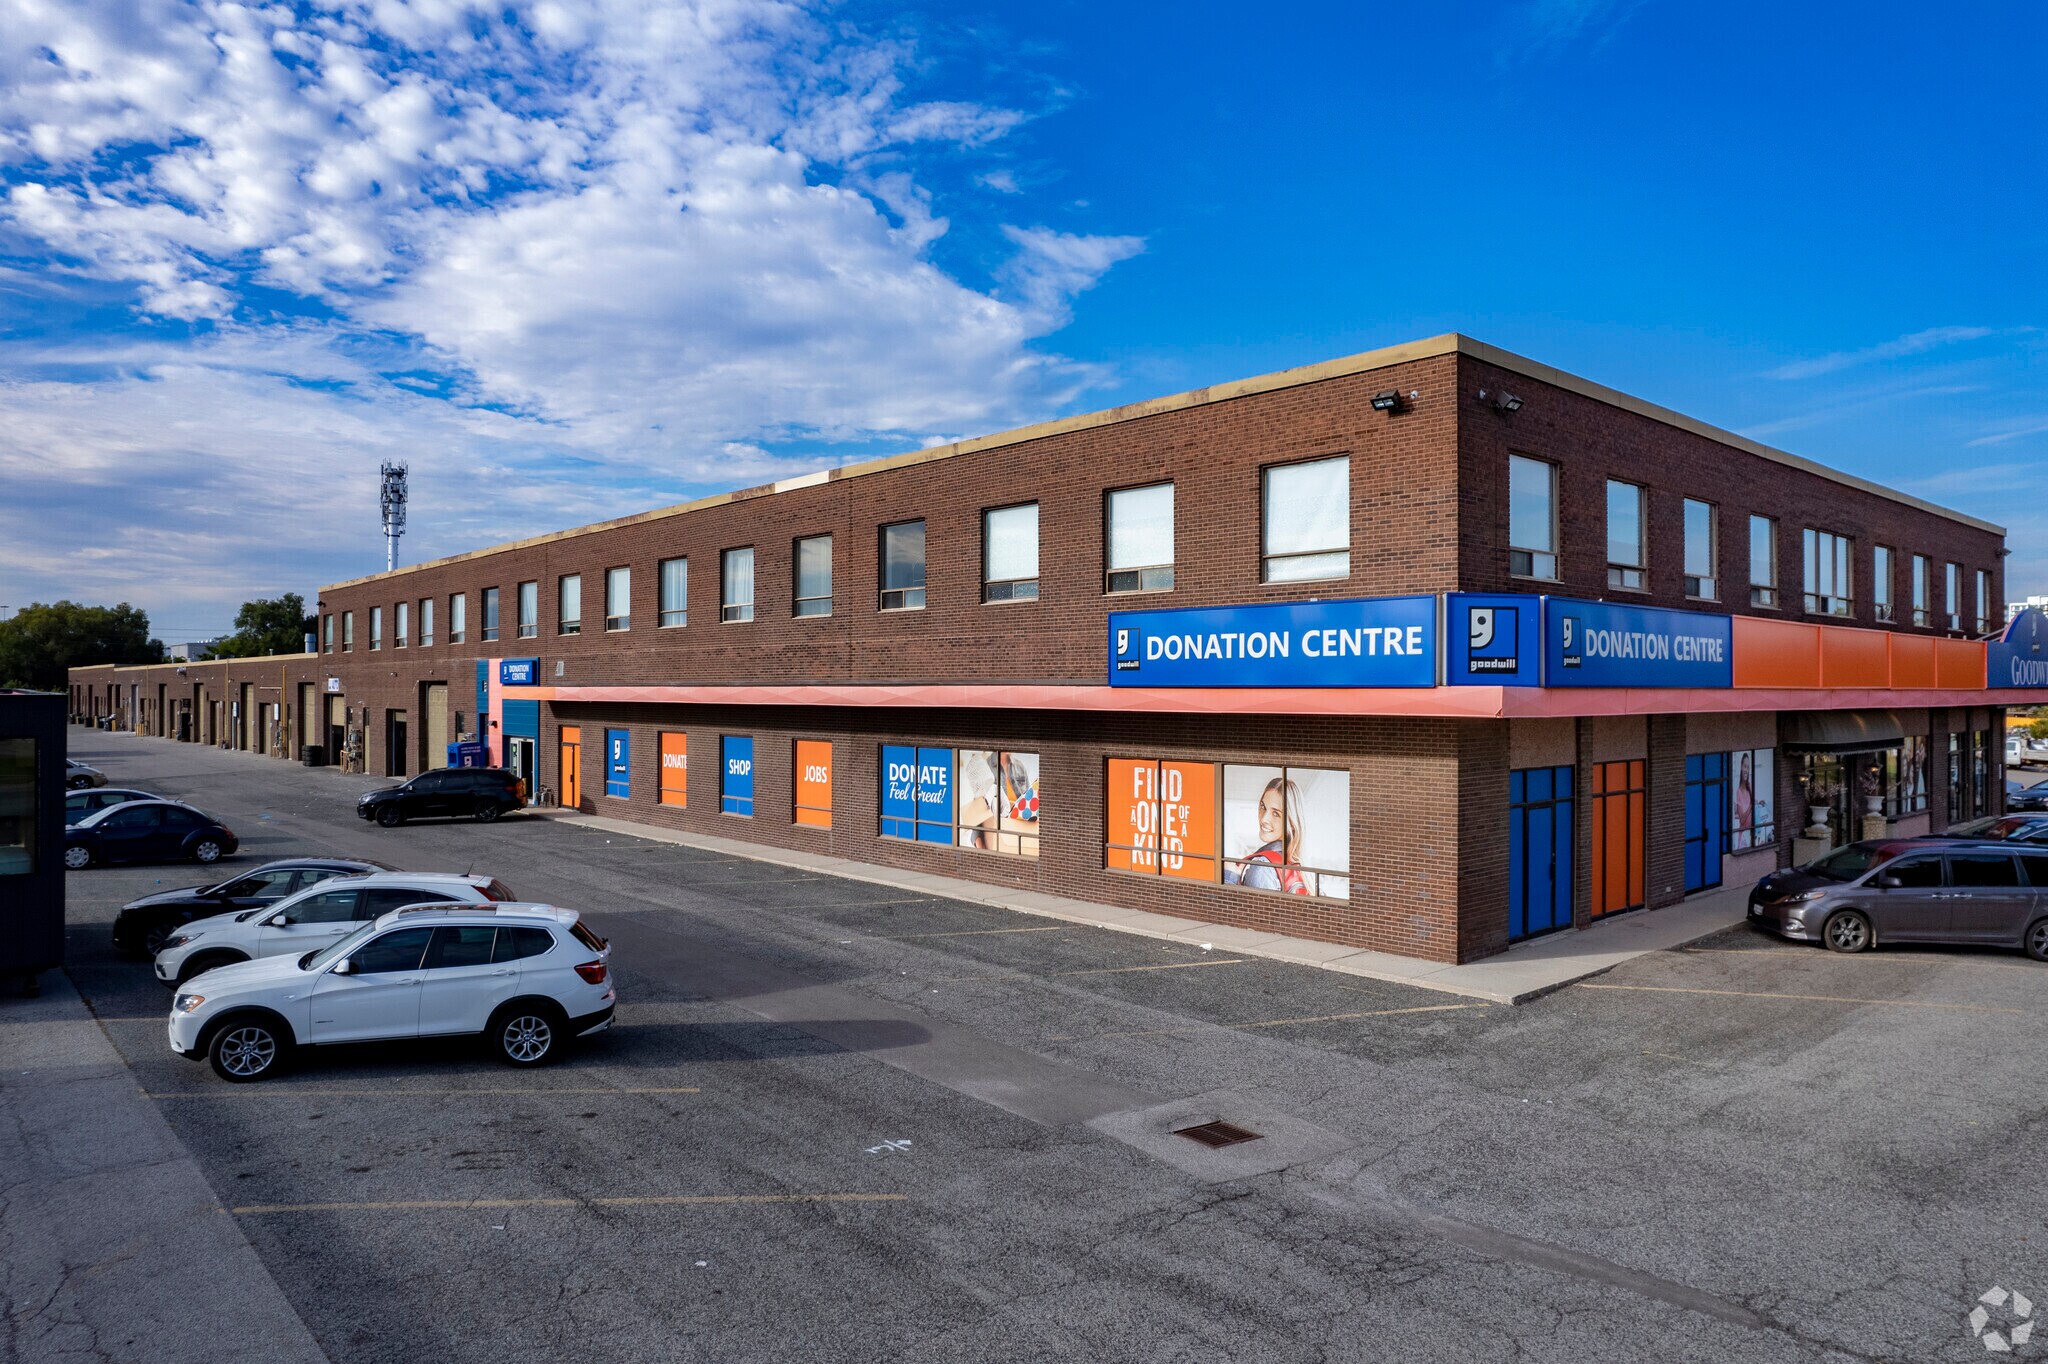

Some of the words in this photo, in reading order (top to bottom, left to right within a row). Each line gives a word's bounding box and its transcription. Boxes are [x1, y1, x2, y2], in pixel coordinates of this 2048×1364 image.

[1147, 631, 1290, 660] DONATION
[1301, 626, 1423, 657] CENTRE
[1585, 629, 1669, 660] DONATION
[1674, 635, 1723, 662] CENTRE
[509, 664, 529, 672] DONATION
[1470, 659, 1516, 672] goodwill
[728, 759, 751, 776] SHOP
[804, 765, 828, 783] JOBS
[889, 763, 947, 786] DONATE
[889, 781, 911, 801] Feel
[911, 784, 947, 804] Great!
[1133, 767, 1183, 802] FIND
[1130, 809, 1136, 823] A
[1137, 801, 1178, 836] ONE
[1178, 805, 1191, 820] OF
[1181, 822, 1188, 837] A
[1131, 833, 1184, 870] KIND
